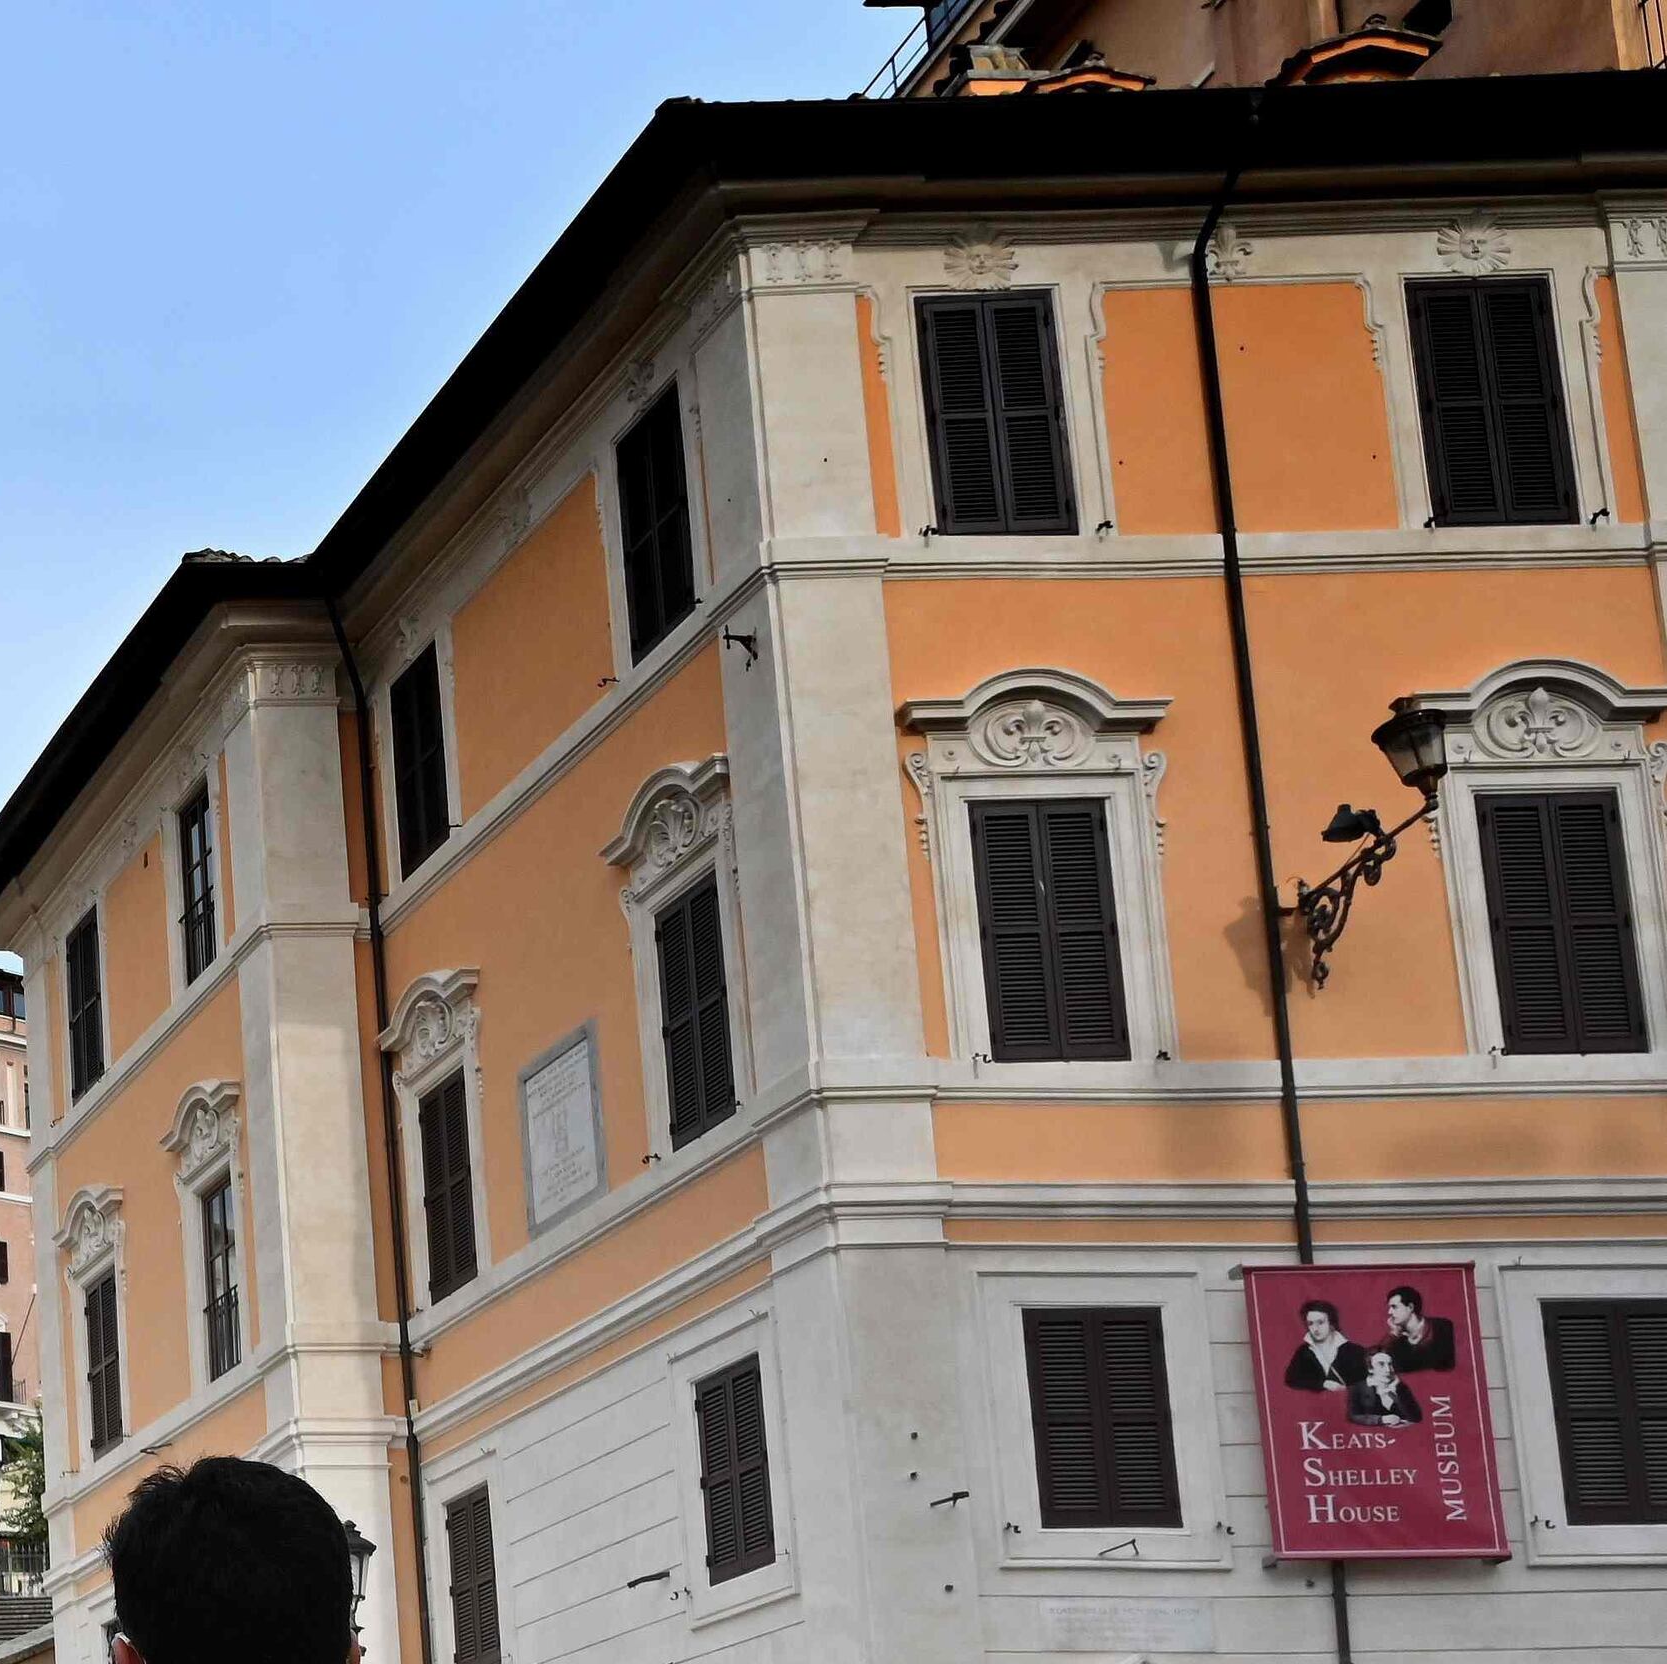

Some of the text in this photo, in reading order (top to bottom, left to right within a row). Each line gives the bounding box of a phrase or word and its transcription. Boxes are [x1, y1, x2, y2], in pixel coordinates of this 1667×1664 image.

[1302, 1456, 1418, 1488] SHELLEY
[1429, 1395, 1468, 1522] MUSEUM
[1305, 1493, 1401, 1525] HOUSE
